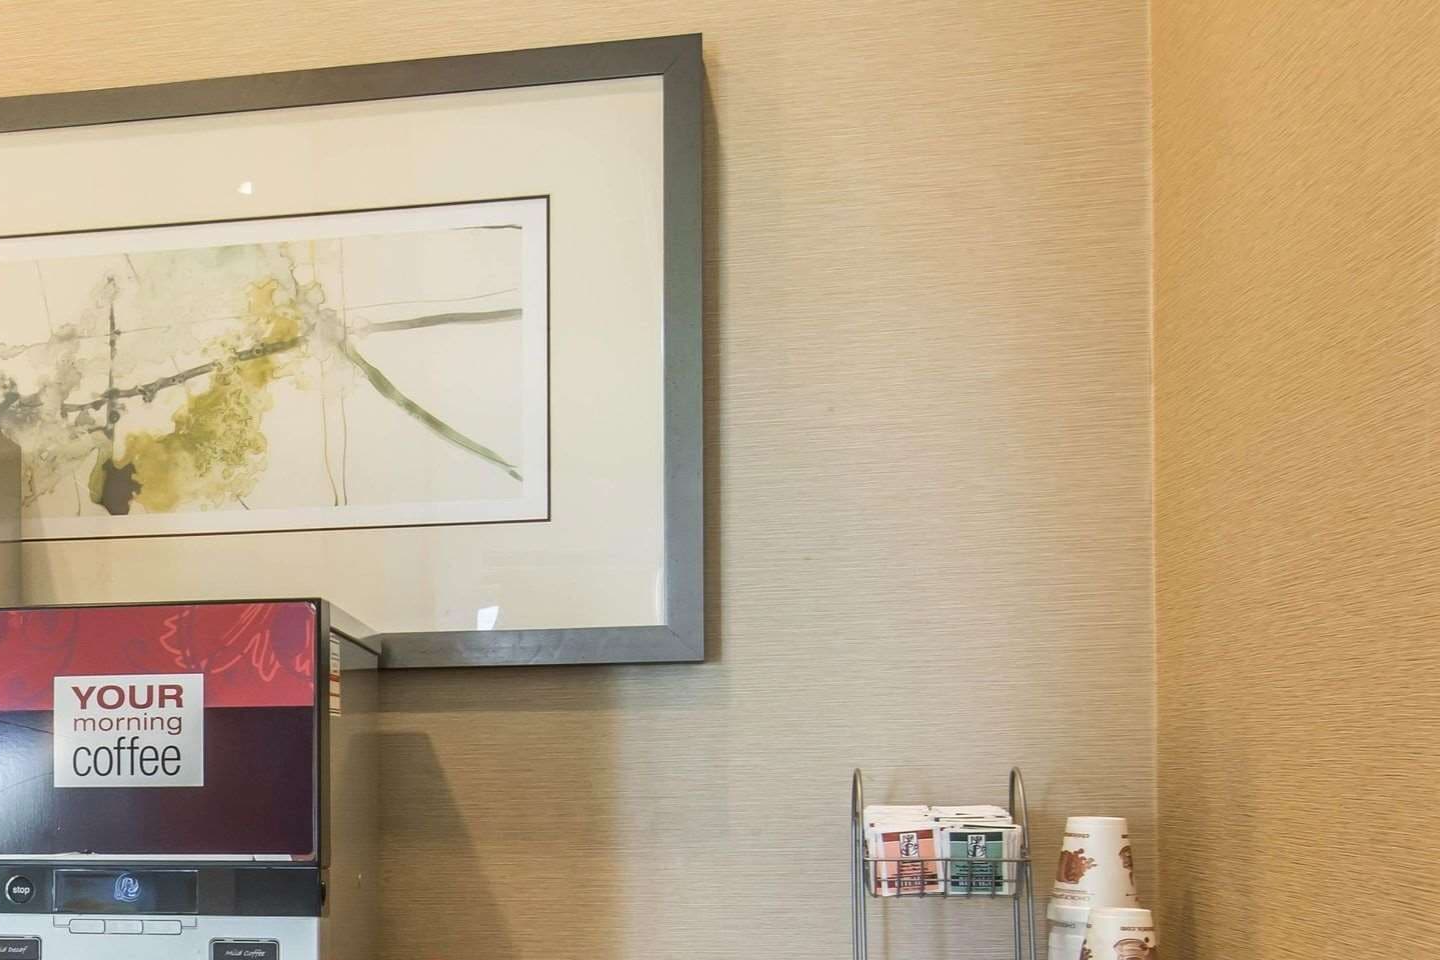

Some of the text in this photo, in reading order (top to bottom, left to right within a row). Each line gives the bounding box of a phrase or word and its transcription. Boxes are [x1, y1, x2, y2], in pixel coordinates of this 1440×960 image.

[72, 684, 184, 710] YOUR
[73, 712, 182, 735] morning
[72, 736, 181, 777] coffee
[12, 886, 30, 896] stop
